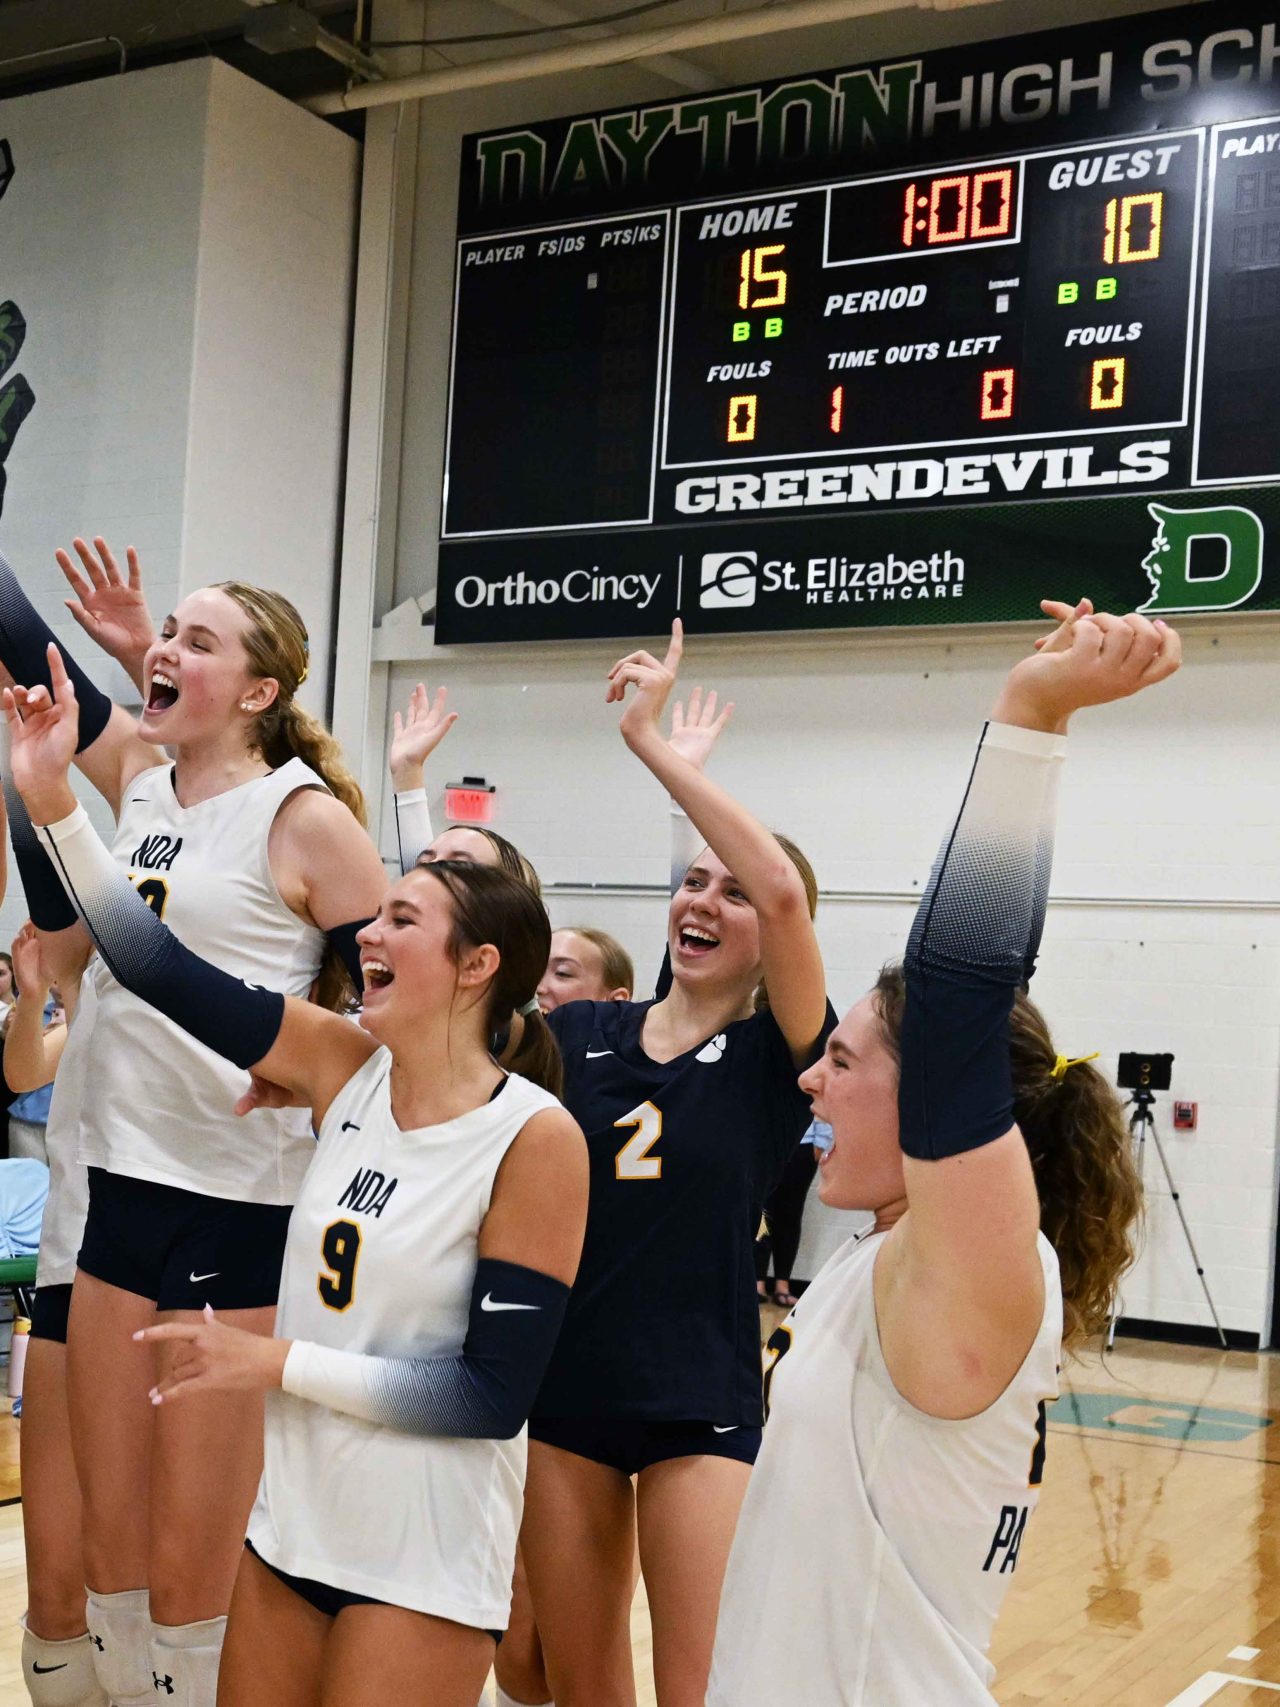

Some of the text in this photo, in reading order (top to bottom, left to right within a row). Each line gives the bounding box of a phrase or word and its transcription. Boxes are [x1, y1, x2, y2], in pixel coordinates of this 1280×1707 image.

[476, 60, 923, 207] DAYTON
[922, 52, 1113, 138] HIGH
[1222, 133, 1280, 158] PLAY
[1048, 145, 1181, 191] GUEST
[698, 202, 798, 241] HOME
[902, 168, 1013, 247] 1:00
[1102, 191, 1163, 265] 10
[466, 224, 661, 267] PLAYER FS/DS PTS/KS
[738, 244, 787, 311] 15
[824, 284, 928, 318] PERIOD
[827, 335, 1001, 371] TIME OUTS LEFT
[1065, 322, 1142, 347] FOULS
[706, 360, 773, 383] FOULS
[1090, 357, 1125, 410] 0
[727, 394, 758, 443] 0
[830, 368, 1014, 434] 1 0
[674, 440, 1171, 514] GREENDEVILS
[454, 566, 662, 609] OrthoCincy
[762, 550, 965, 592] St. Elizabeth
[806, 584, 964, 604] HEALTHCARE
[130, 834, 183, 871] NDA
[613, 1100, 663, 1180] 2
[337, 1166, 399, 1219] NDA
[317, 1217, 363, 1314] 9
